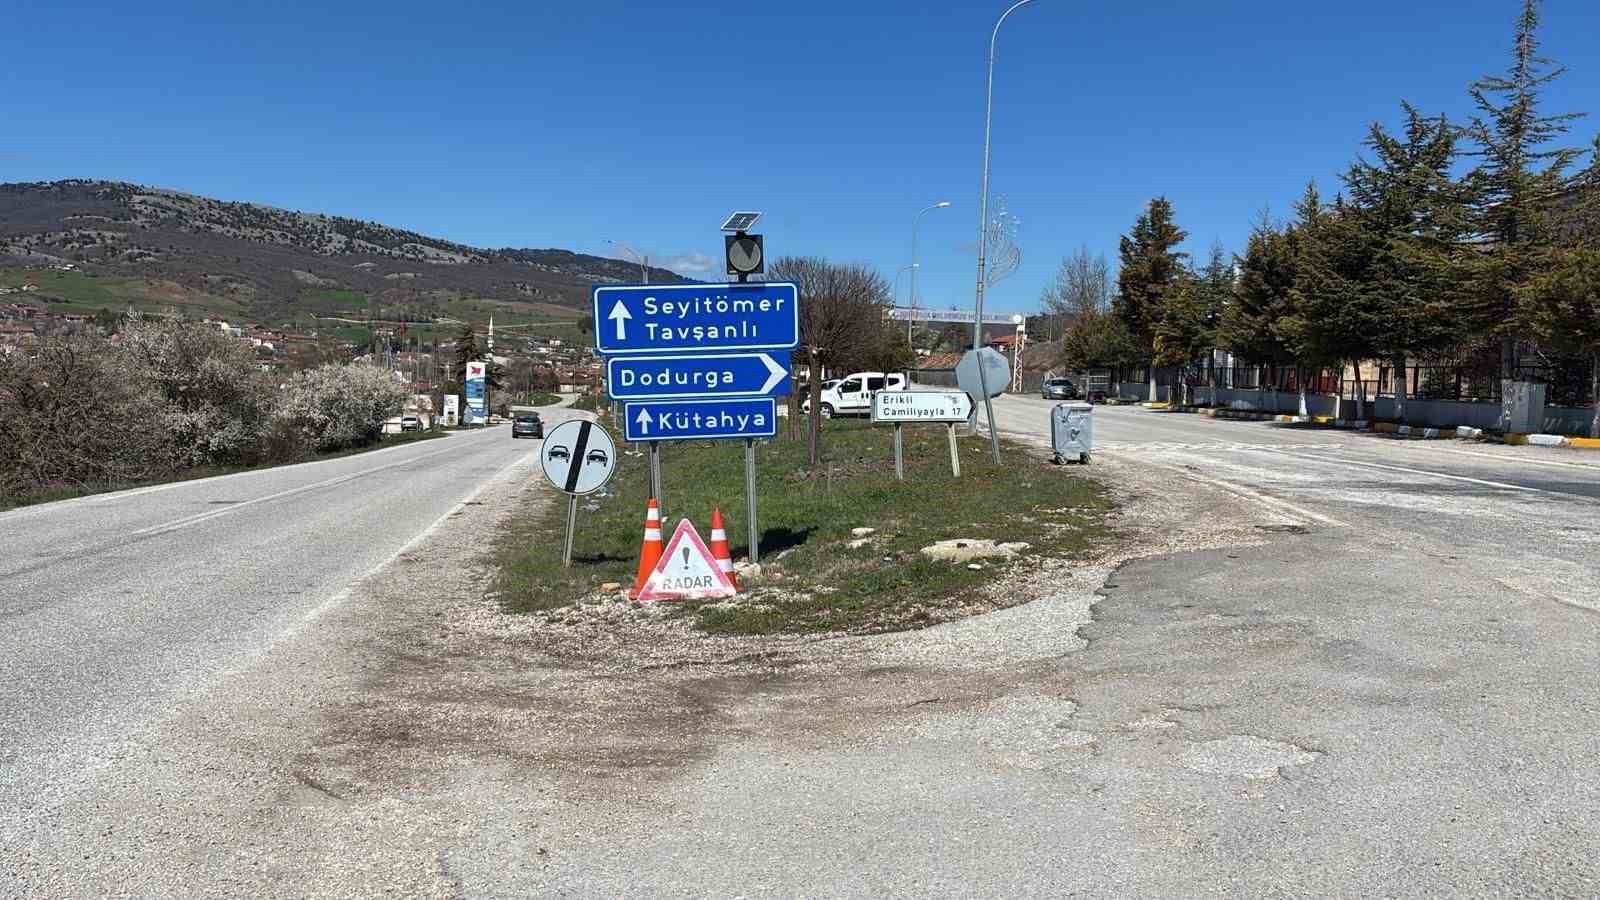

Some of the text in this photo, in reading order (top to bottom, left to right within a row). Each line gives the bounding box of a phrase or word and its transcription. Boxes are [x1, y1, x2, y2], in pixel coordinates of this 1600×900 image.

[644, 296, 784, 319] Seyitömer
[645, 321, 757, 341] Tavşanlı
[621, 368, 734, 388] Dodurga
[658, 411, 765, 431] Kütahya
[952, 407, 961, 415] 17
[663, 575, 713, 590] RADAR
